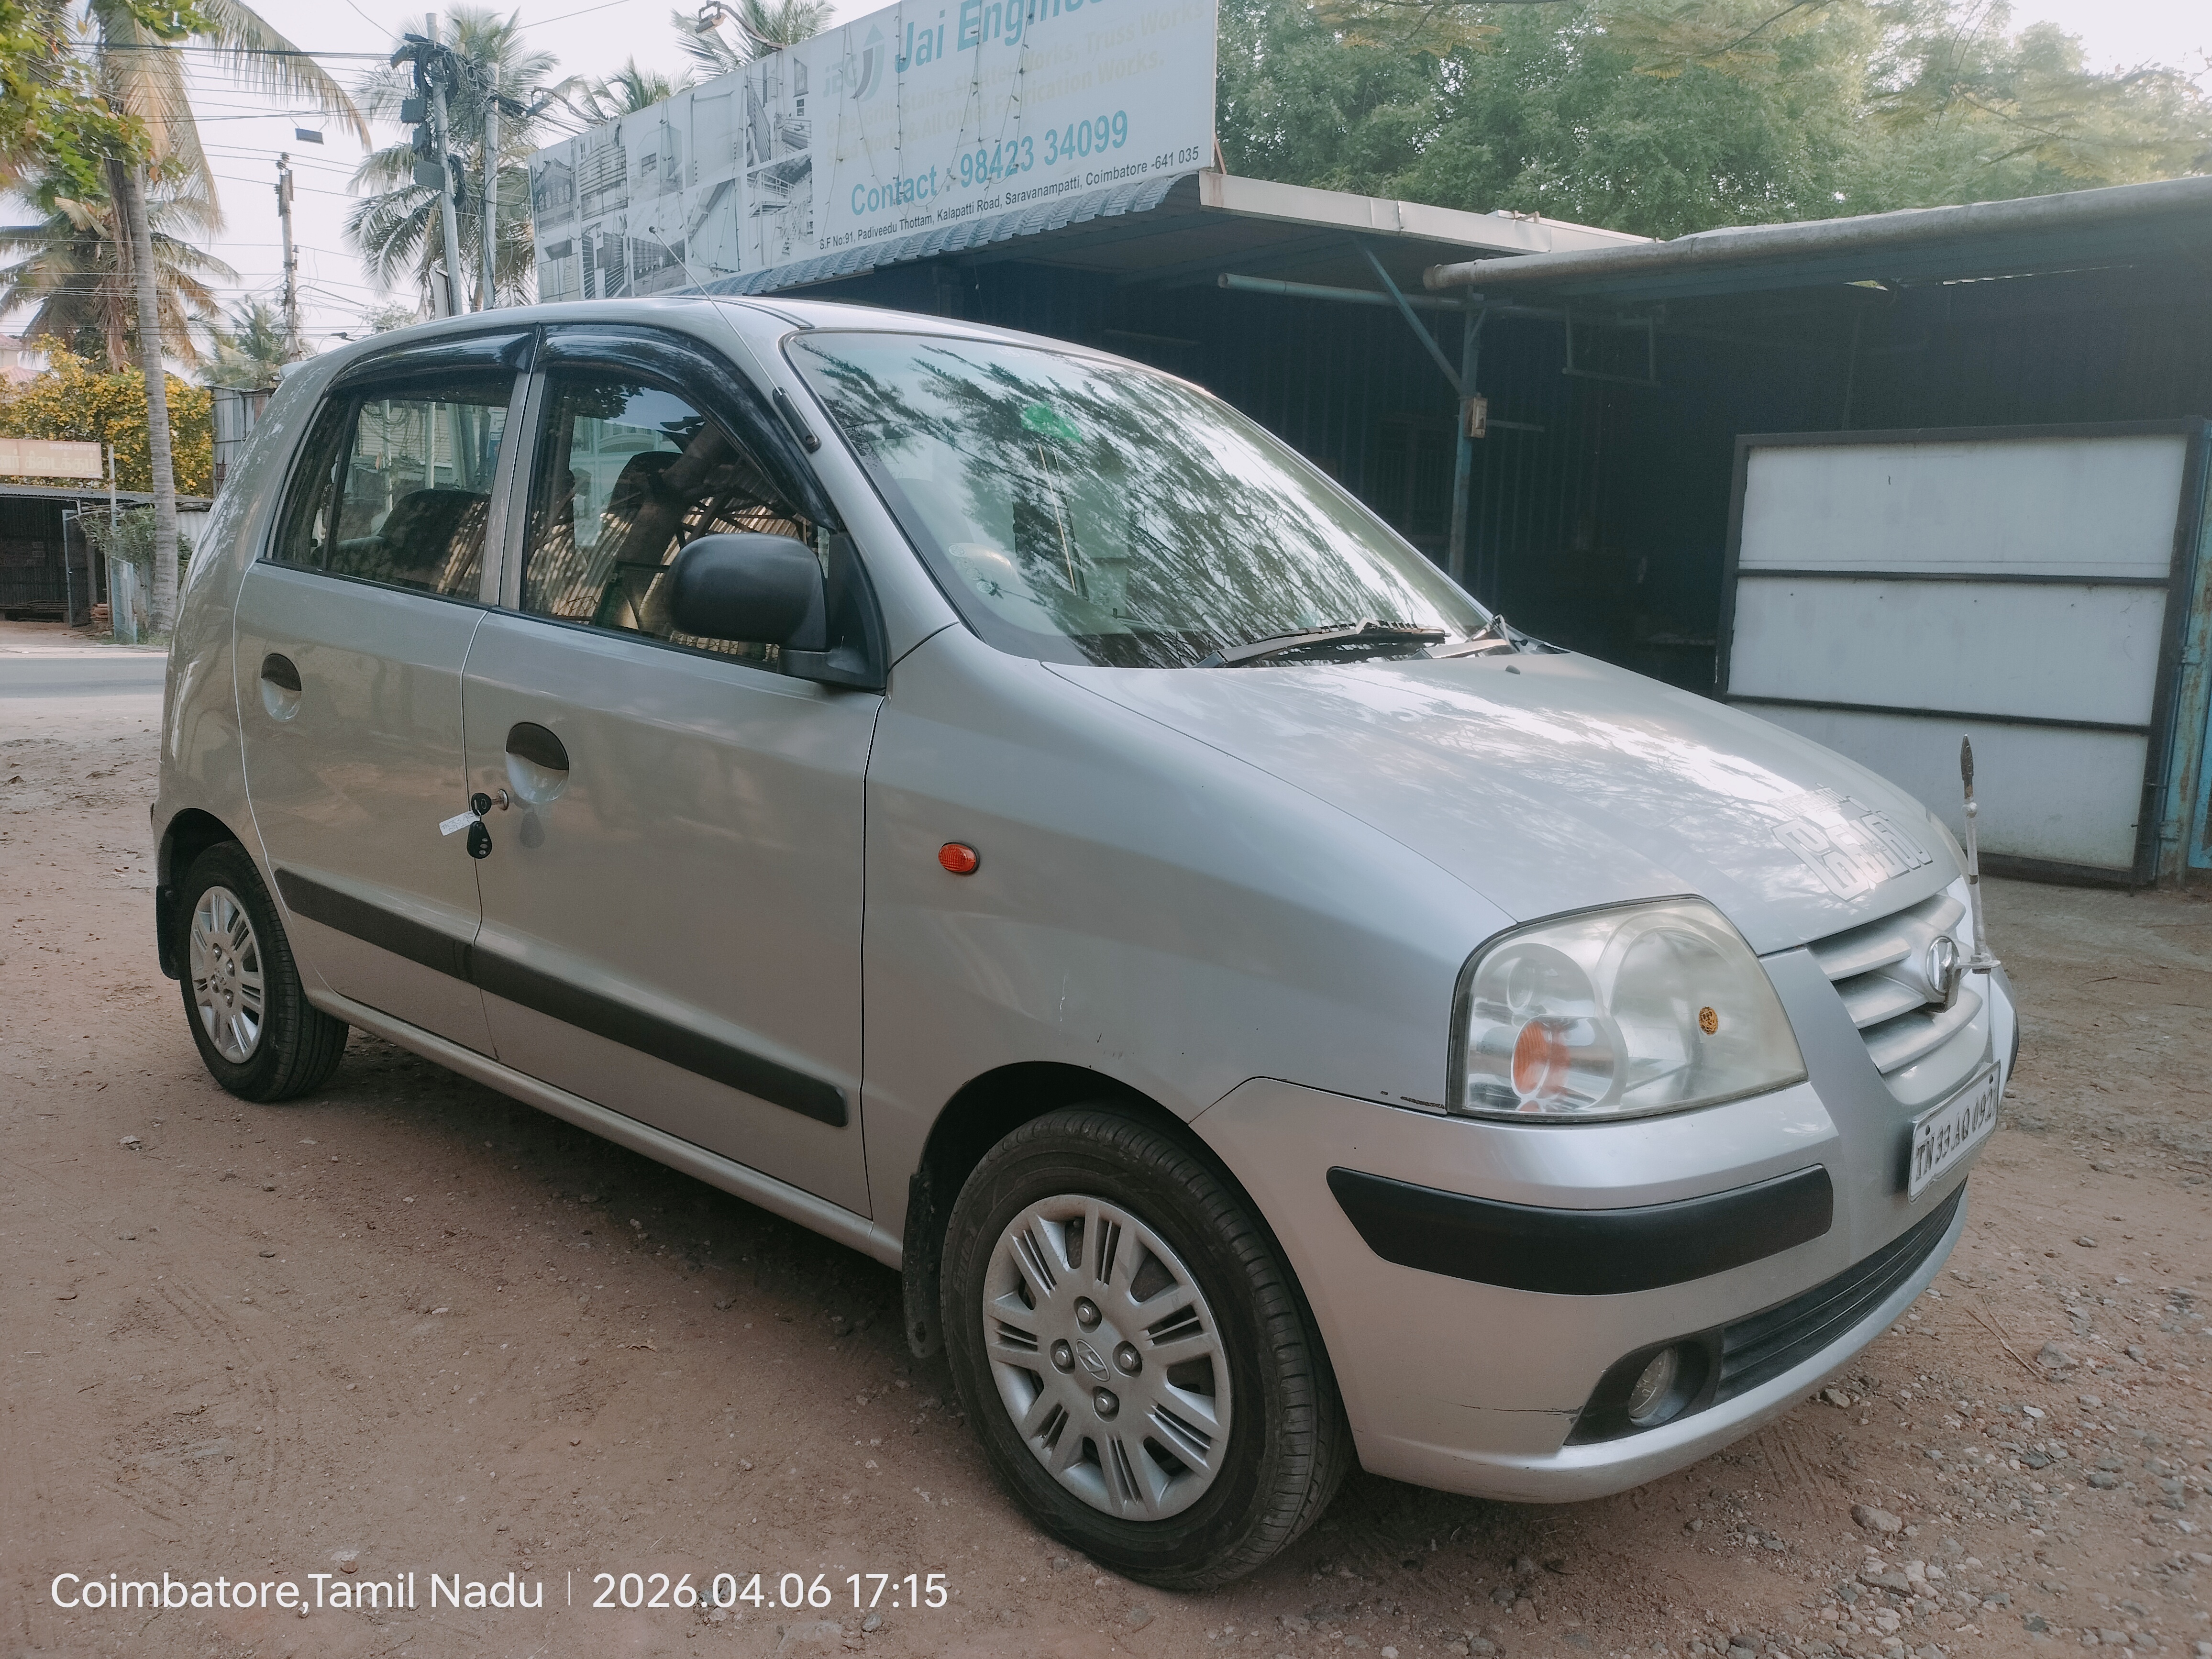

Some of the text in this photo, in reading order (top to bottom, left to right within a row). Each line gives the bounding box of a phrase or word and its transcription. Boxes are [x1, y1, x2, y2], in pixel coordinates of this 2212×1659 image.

[895, 0, 1103, 73] Jai Engin
[1087, 22, 1135, 55] Truss
[1140, 1, 1204, 37] Works
[921, 111, 943, 138] All
[945, 101, 990, 131] Other
[994, 69, 1093, 116] Fabrication
[1098, 49, 1164, 84] Works.
[819, 237, 831, 250] S.F
[833, 232, 856, 246] No:91,
[858, 221, 897, 241] Padiveedu
[899, 214, 935, 231] Thottam,
[937, 201, 974, 221] Kalapatti
[977, 195, 1003, 212] Road,
[1005, 175, 1083, 205] Saravanampatti,
[1086, 162, 1148, 186] Coimbatore
[1178, 145, 1199, 164] 035
[852, 165, 937, 216] Contact
[961, 136, 1034, 188] 98423
[1044, 110, 1128, 166] 34099
